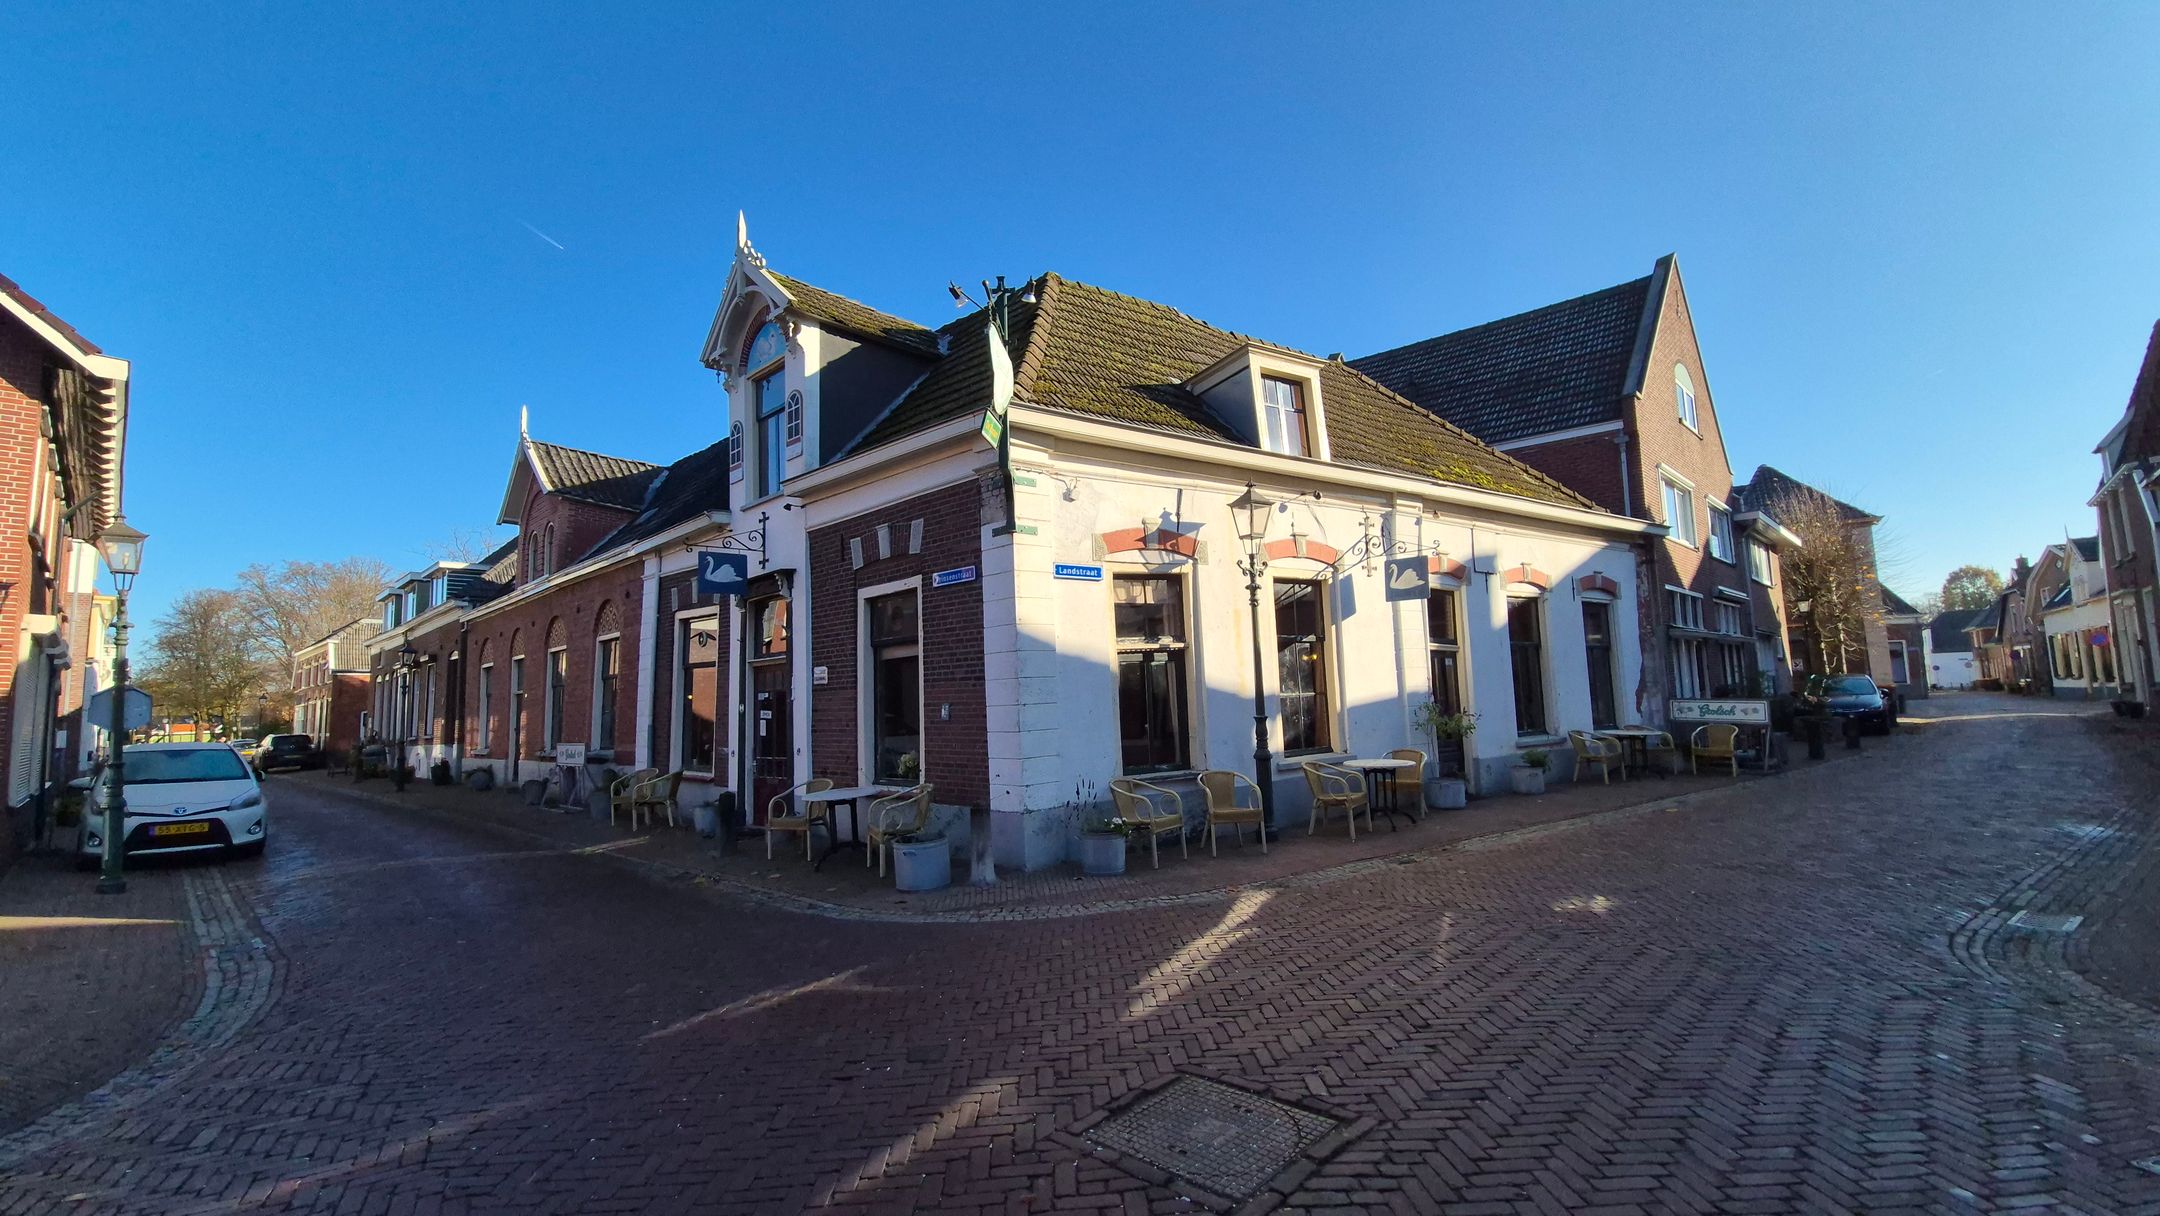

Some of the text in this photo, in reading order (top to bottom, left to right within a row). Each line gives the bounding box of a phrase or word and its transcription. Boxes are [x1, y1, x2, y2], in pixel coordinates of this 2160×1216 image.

[936, 570, 972, 584] rinsenstraat
[1058, 566, 1098, 577] Landstraat
[1697, 703, 1737, 717] Grolsch
